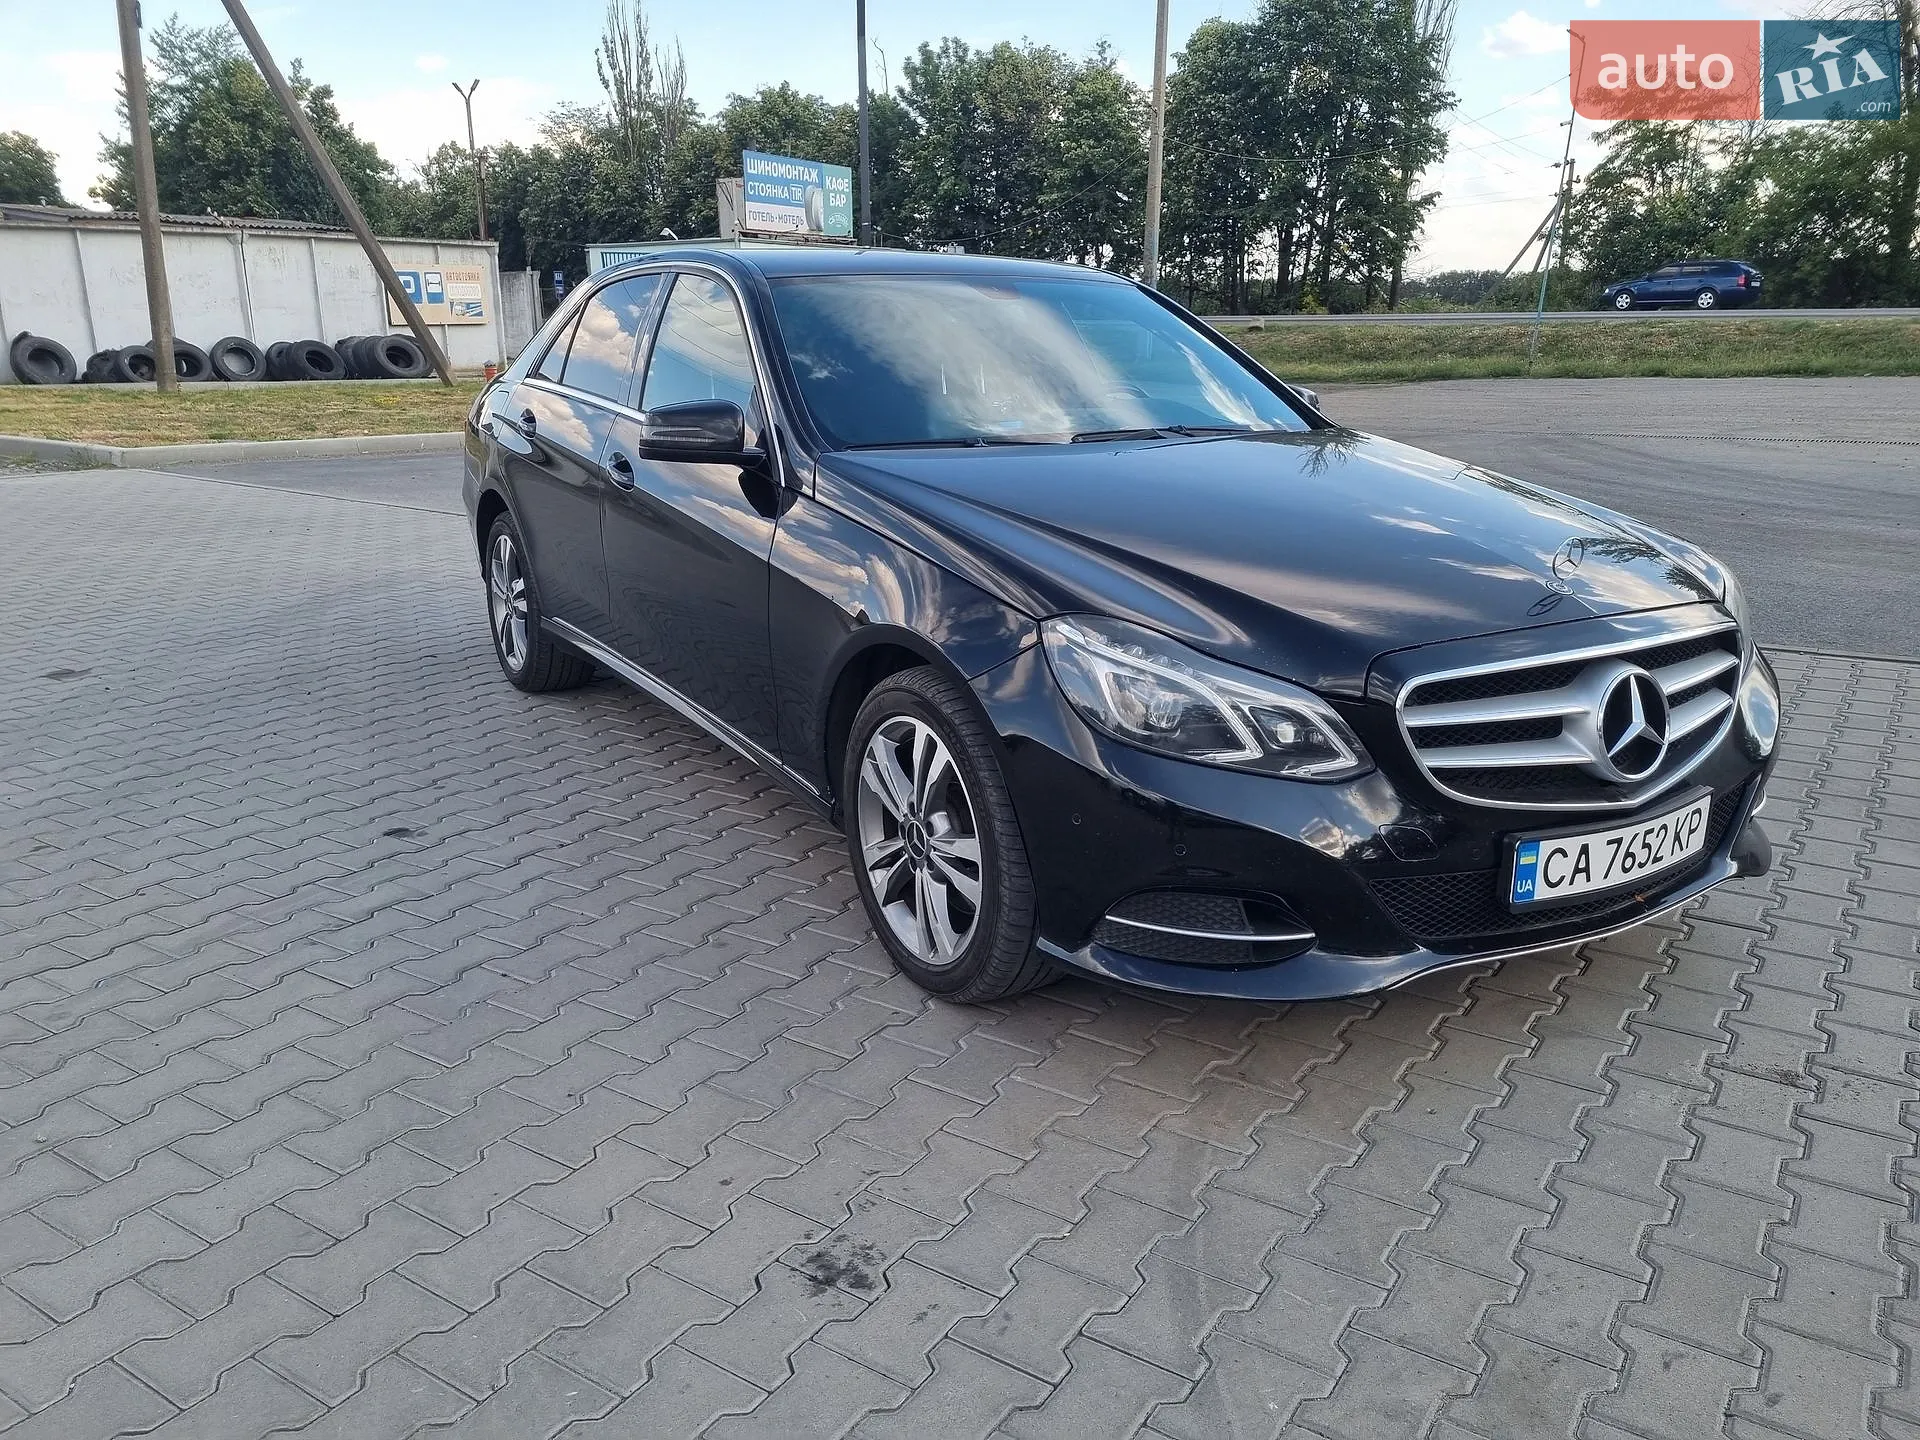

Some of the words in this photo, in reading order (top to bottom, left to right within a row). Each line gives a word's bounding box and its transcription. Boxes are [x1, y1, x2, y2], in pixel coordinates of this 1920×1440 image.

[746, 158, 819, 183] ШИНОМОНТАЖ
[747, 182, 790, 200] СТОЯНКА
[791, 186, 804, 201] TIR
[826, 176, 849, 192] КАФЕ
[829, 193, 847, 208] БАР
[1542, 842, 1592, 889] CA
[1602, 823, 1669, 880] 7652
[1670, 807, 1703, 857] KP
[1516, 878, 1534, 893] UA
